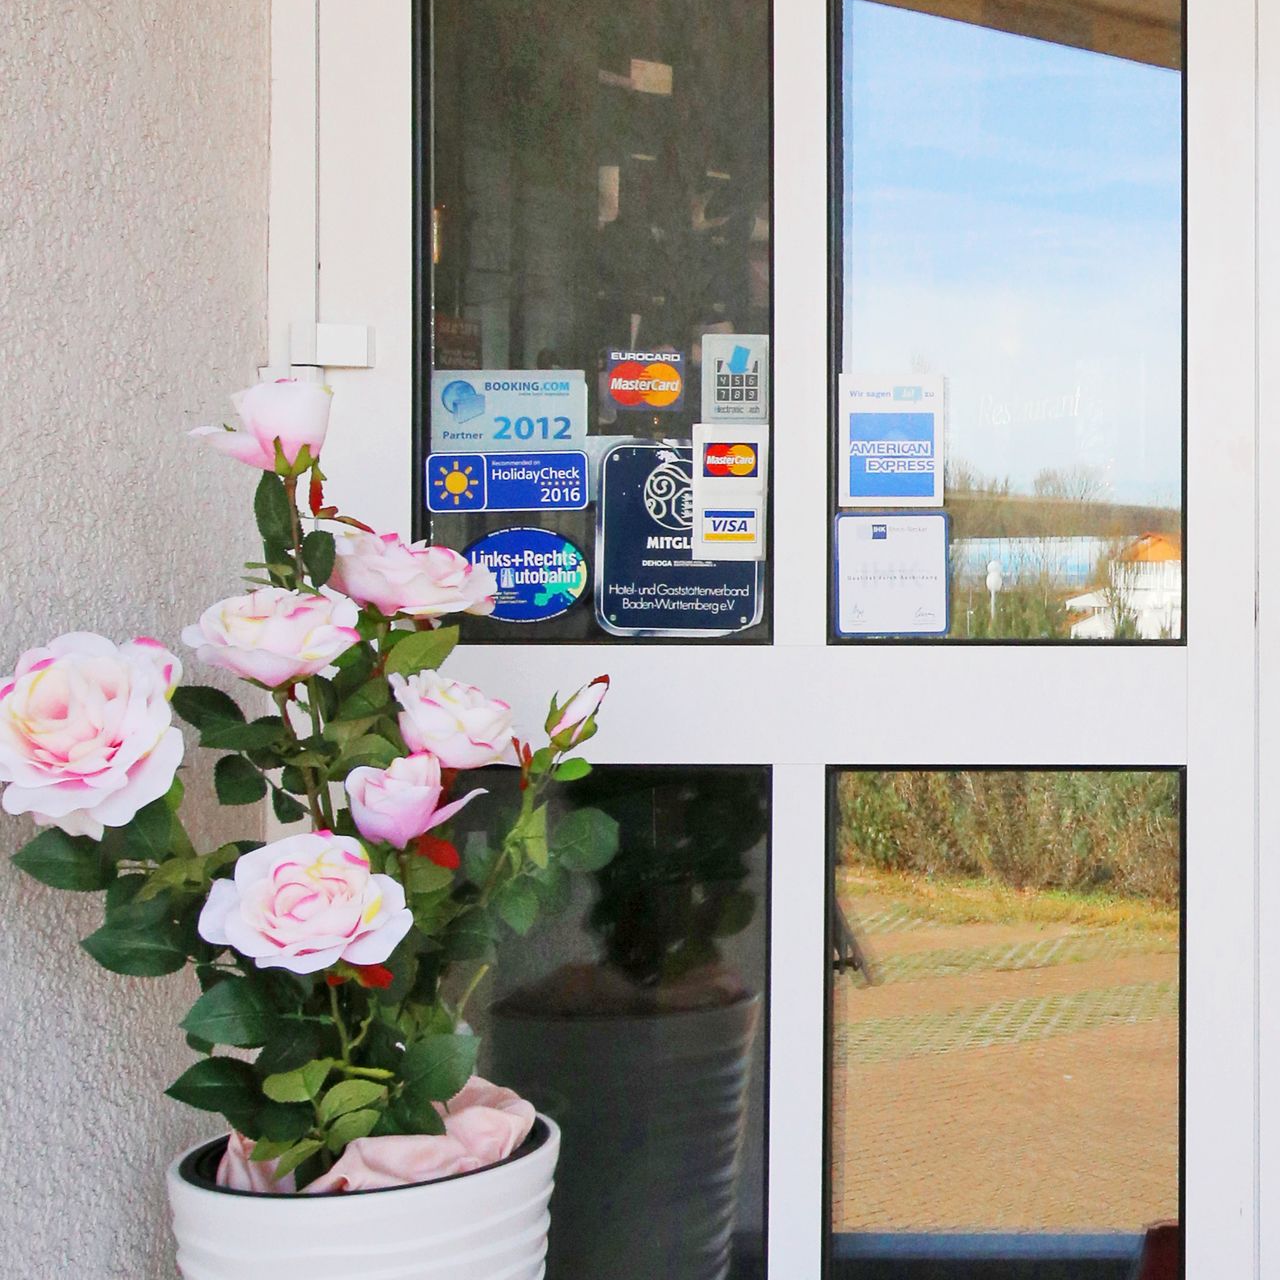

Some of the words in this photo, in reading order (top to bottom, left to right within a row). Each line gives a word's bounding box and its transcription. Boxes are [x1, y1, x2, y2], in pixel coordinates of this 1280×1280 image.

[611, 353, 680, 361] EUROCARD
[485, 382, 569, 391] BOOKING.COM
[610, 377, 679, 392] MasterCard
[849, 390, 864, 398] Wir
[866, 391, 891, 399] sagen
[493, 416, 572, 440] 2012
[443, 431, 483, 440] Partner
[850, 443, 929, 455] AMERICAN
[706, 454, 755, 466] MasterCard
[868, 460, 934, 472] EXPRESS
[492, 467, 580, 483] HolidayCheck
[540, 488, 580, 502] 2016
[710, 519, 748, 533] VISA
[646, 537, 693, 549] MITGL
[472, 550, 576, 567] Links+Rechts
[609, 583, 638, 594] Hotel-
[638, 583, 656, 595] und
